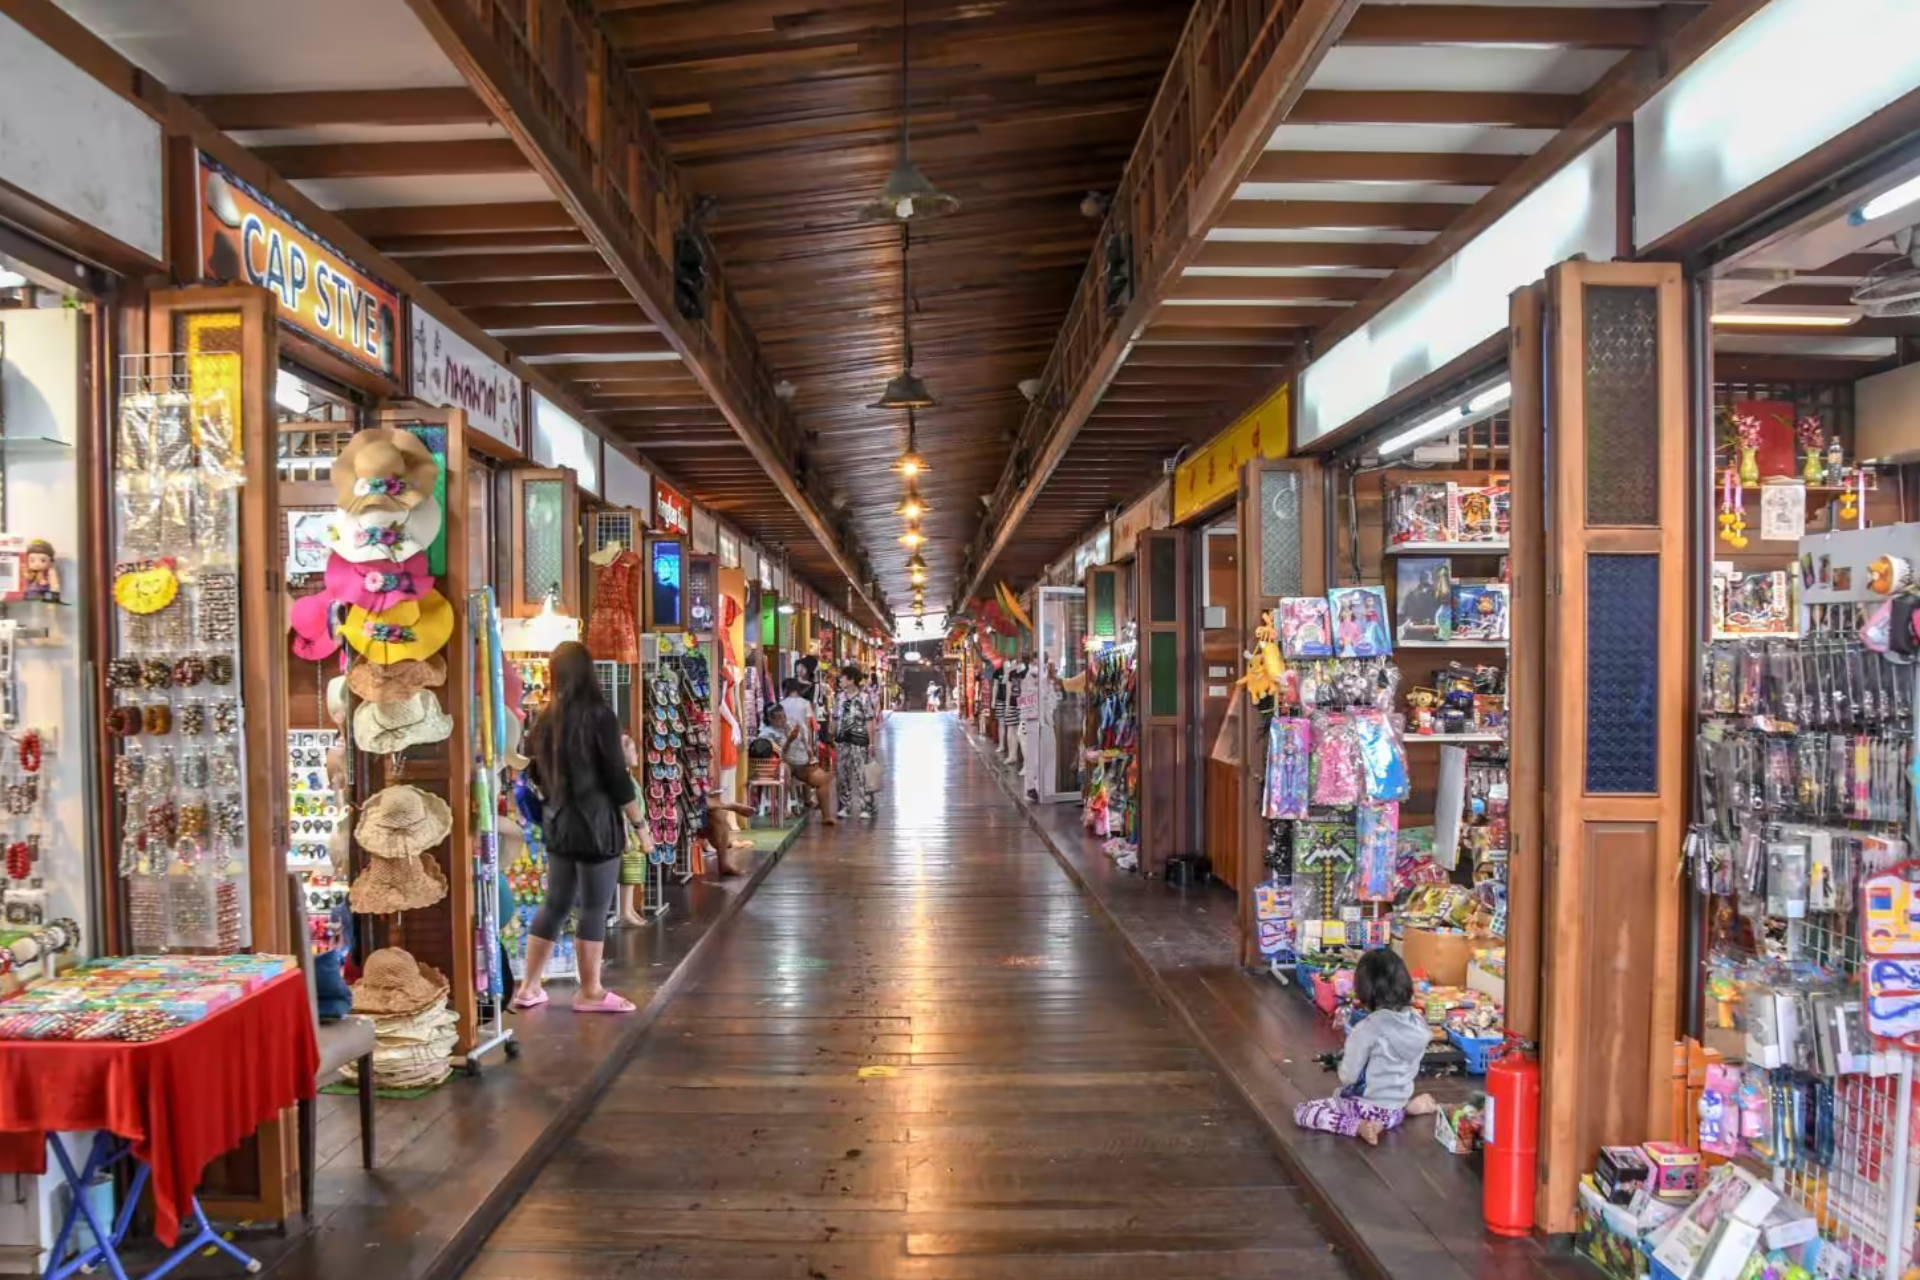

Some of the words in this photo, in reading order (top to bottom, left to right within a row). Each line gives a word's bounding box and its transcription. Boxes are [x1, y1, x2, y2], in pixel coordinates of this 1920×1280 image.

[241, 211, 307, 312] CAP
[314, 261, 380, 358] STYE
[116, 559, 155, 574] SALE
